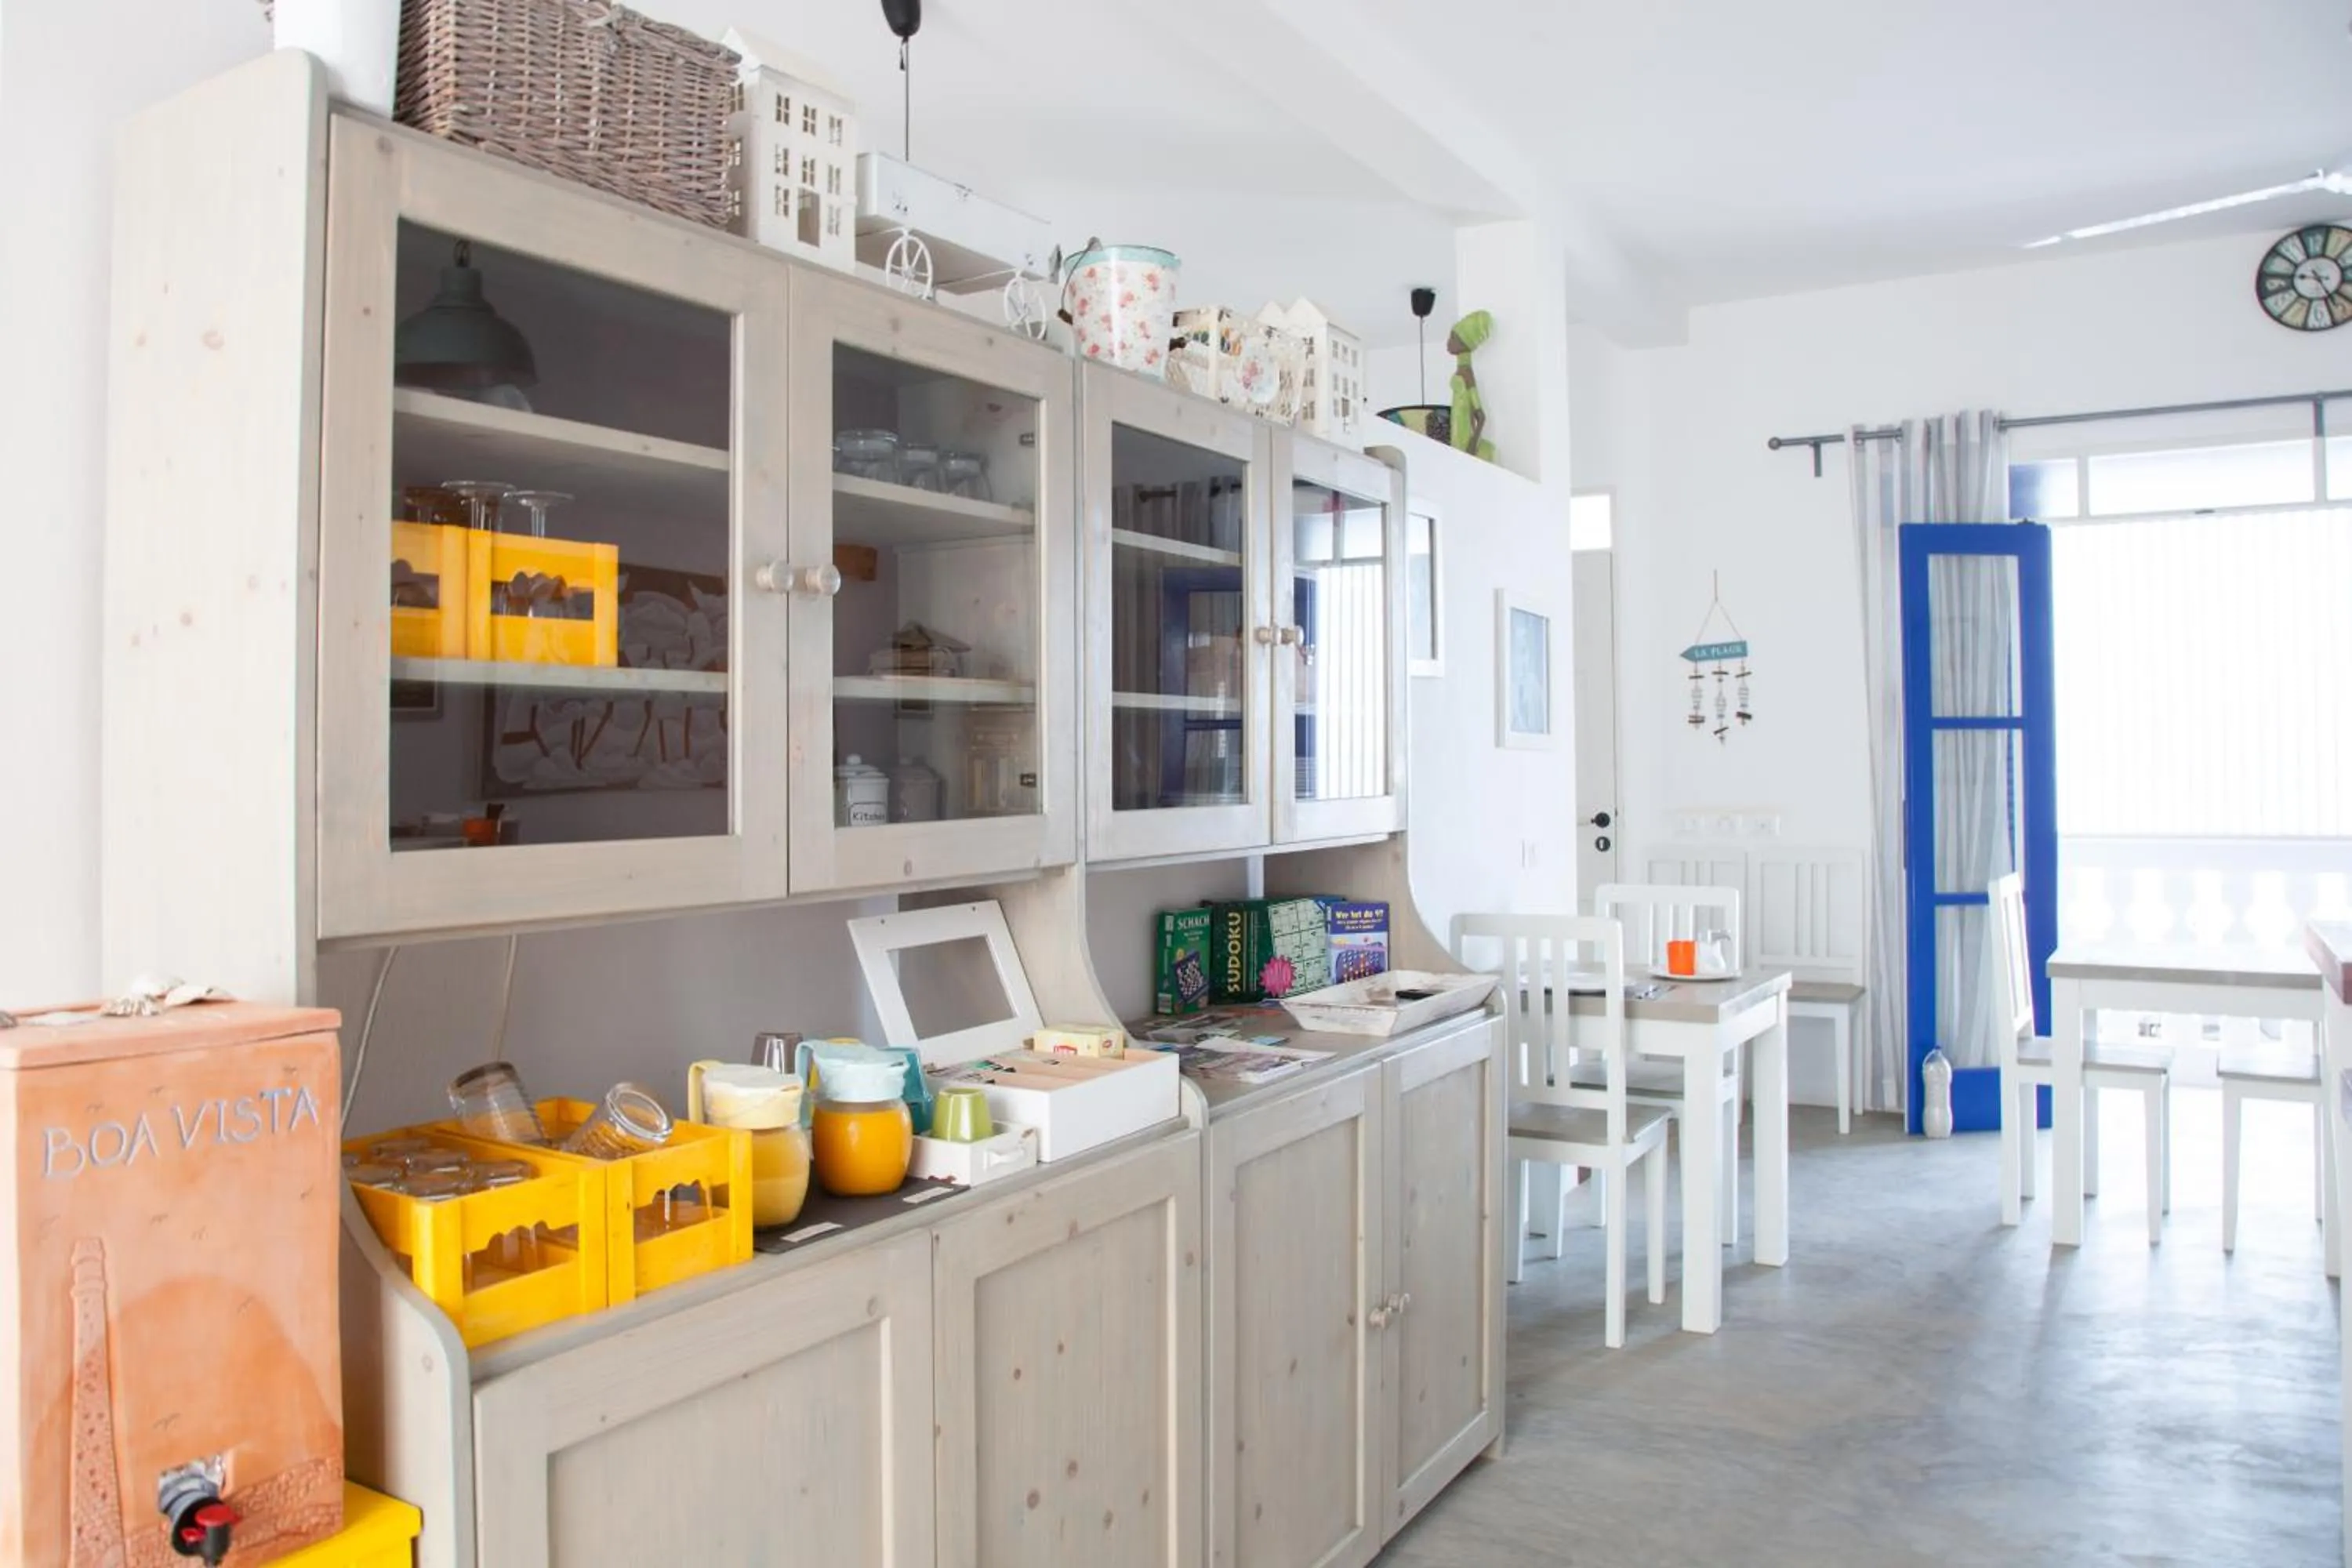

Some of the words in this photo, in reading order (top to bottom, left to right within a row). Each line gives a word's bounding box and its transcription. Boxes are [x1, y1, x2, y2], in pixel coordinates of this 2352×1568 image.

[1177, 915, 1210, 931] SCHACH
[1227, 912, 1241, 993] SUDOKU
[43, 1112, 161, 1179] BOA
[170, 1085, 321, 1150] VISTA
